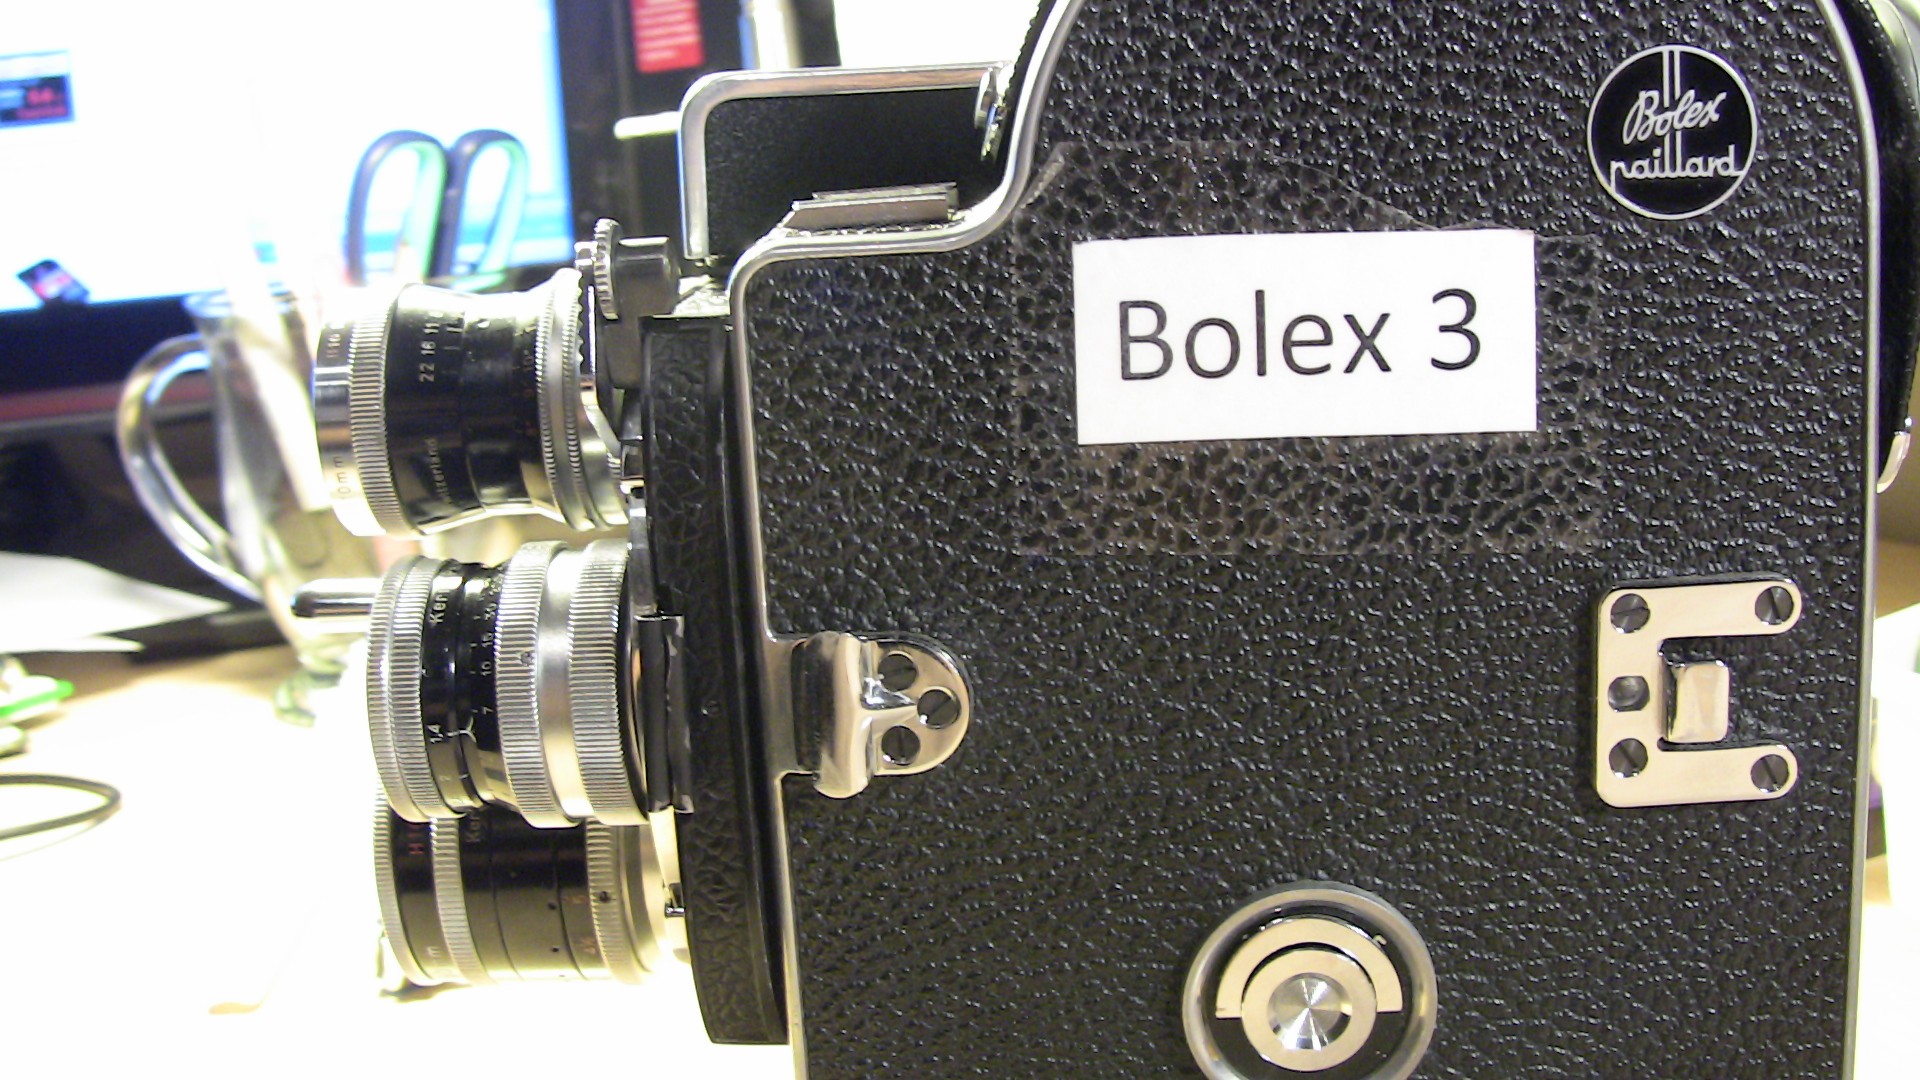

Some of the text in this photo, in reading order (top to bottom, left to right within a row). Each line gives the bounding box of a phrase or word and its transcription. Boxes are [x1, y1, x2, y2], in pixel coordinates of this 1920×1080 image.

[1622, 88, 1727, 145] Bolex
[1609, 144, 1745, 192] paillard
[420, 340, 436, 356] 16
[1118, 288, 1482, 381] Bolex 3
[419, 362, 435, 383] 22
[481, 661, 492, 677] 10
